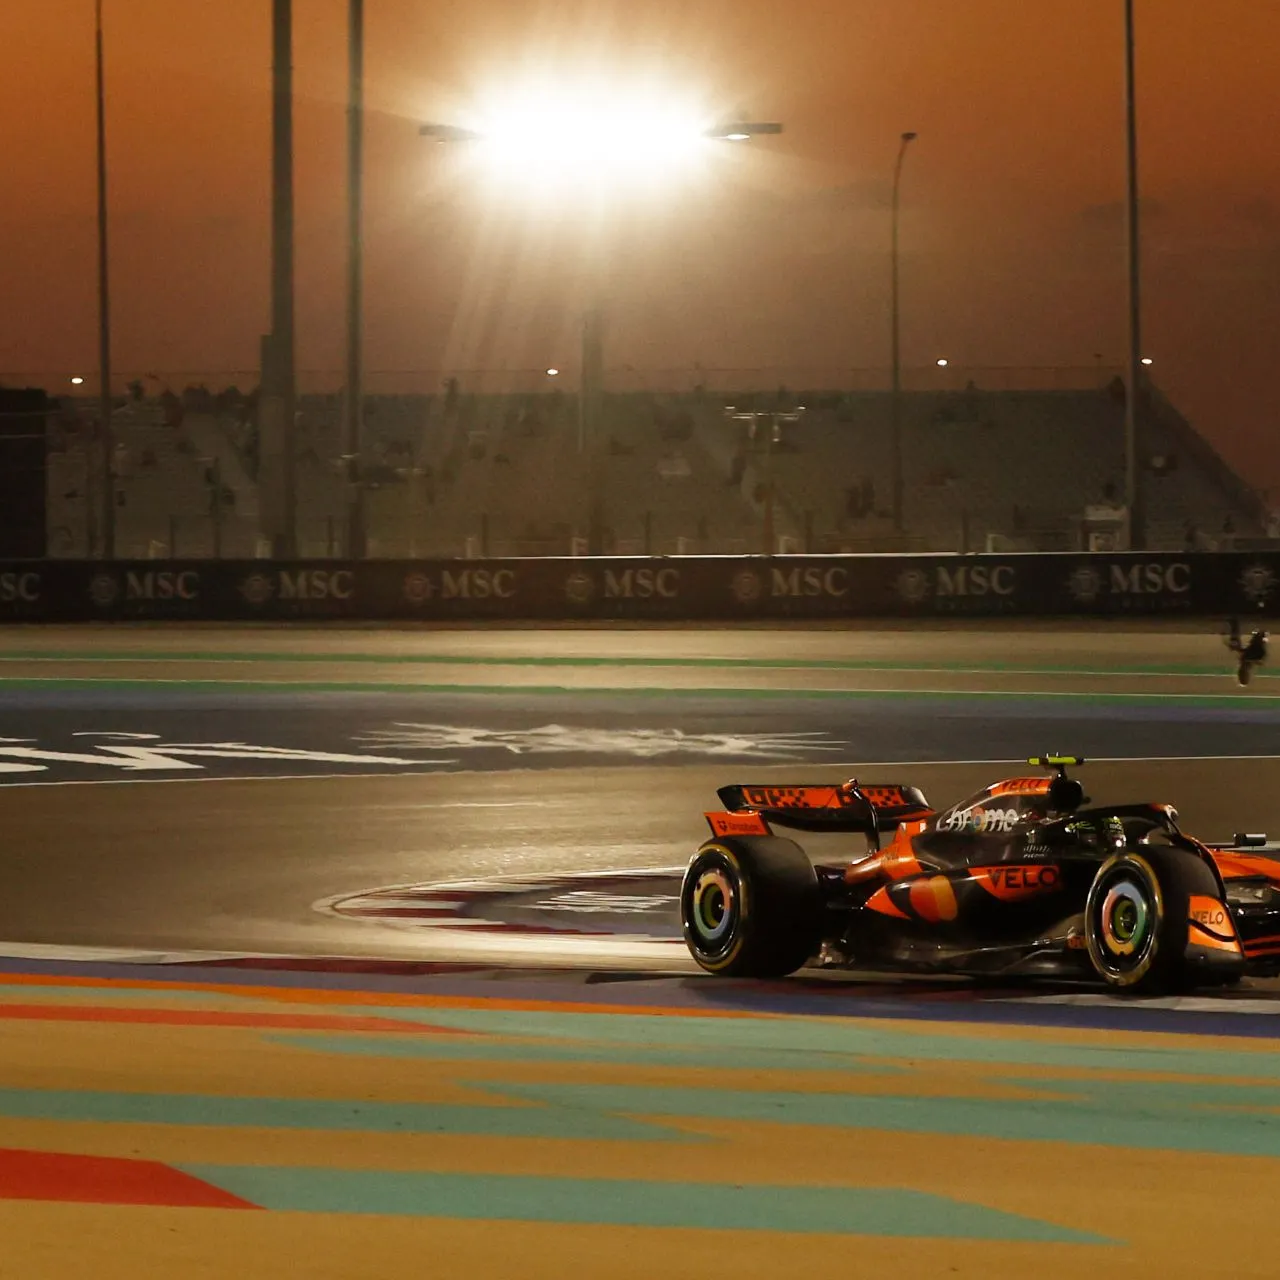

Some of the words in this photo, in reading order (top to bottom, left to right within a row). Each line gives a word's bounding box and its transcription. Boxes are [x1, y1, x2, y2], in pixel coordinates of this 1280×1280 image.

[127, 572, 198, 599] MSC
[279, 571, 352, 598] MSC
[442, 570, 515, 597] MSC
[604, 569, 679, 597] MSC
[771, 568, 846, 596] MSC
[936, 566, 1013, 595] MSC
[1111, 564, 1189, 593] MSC
[986, 867, 1058, 889] VELO
[1192, 910, 1224, 926] VELO
